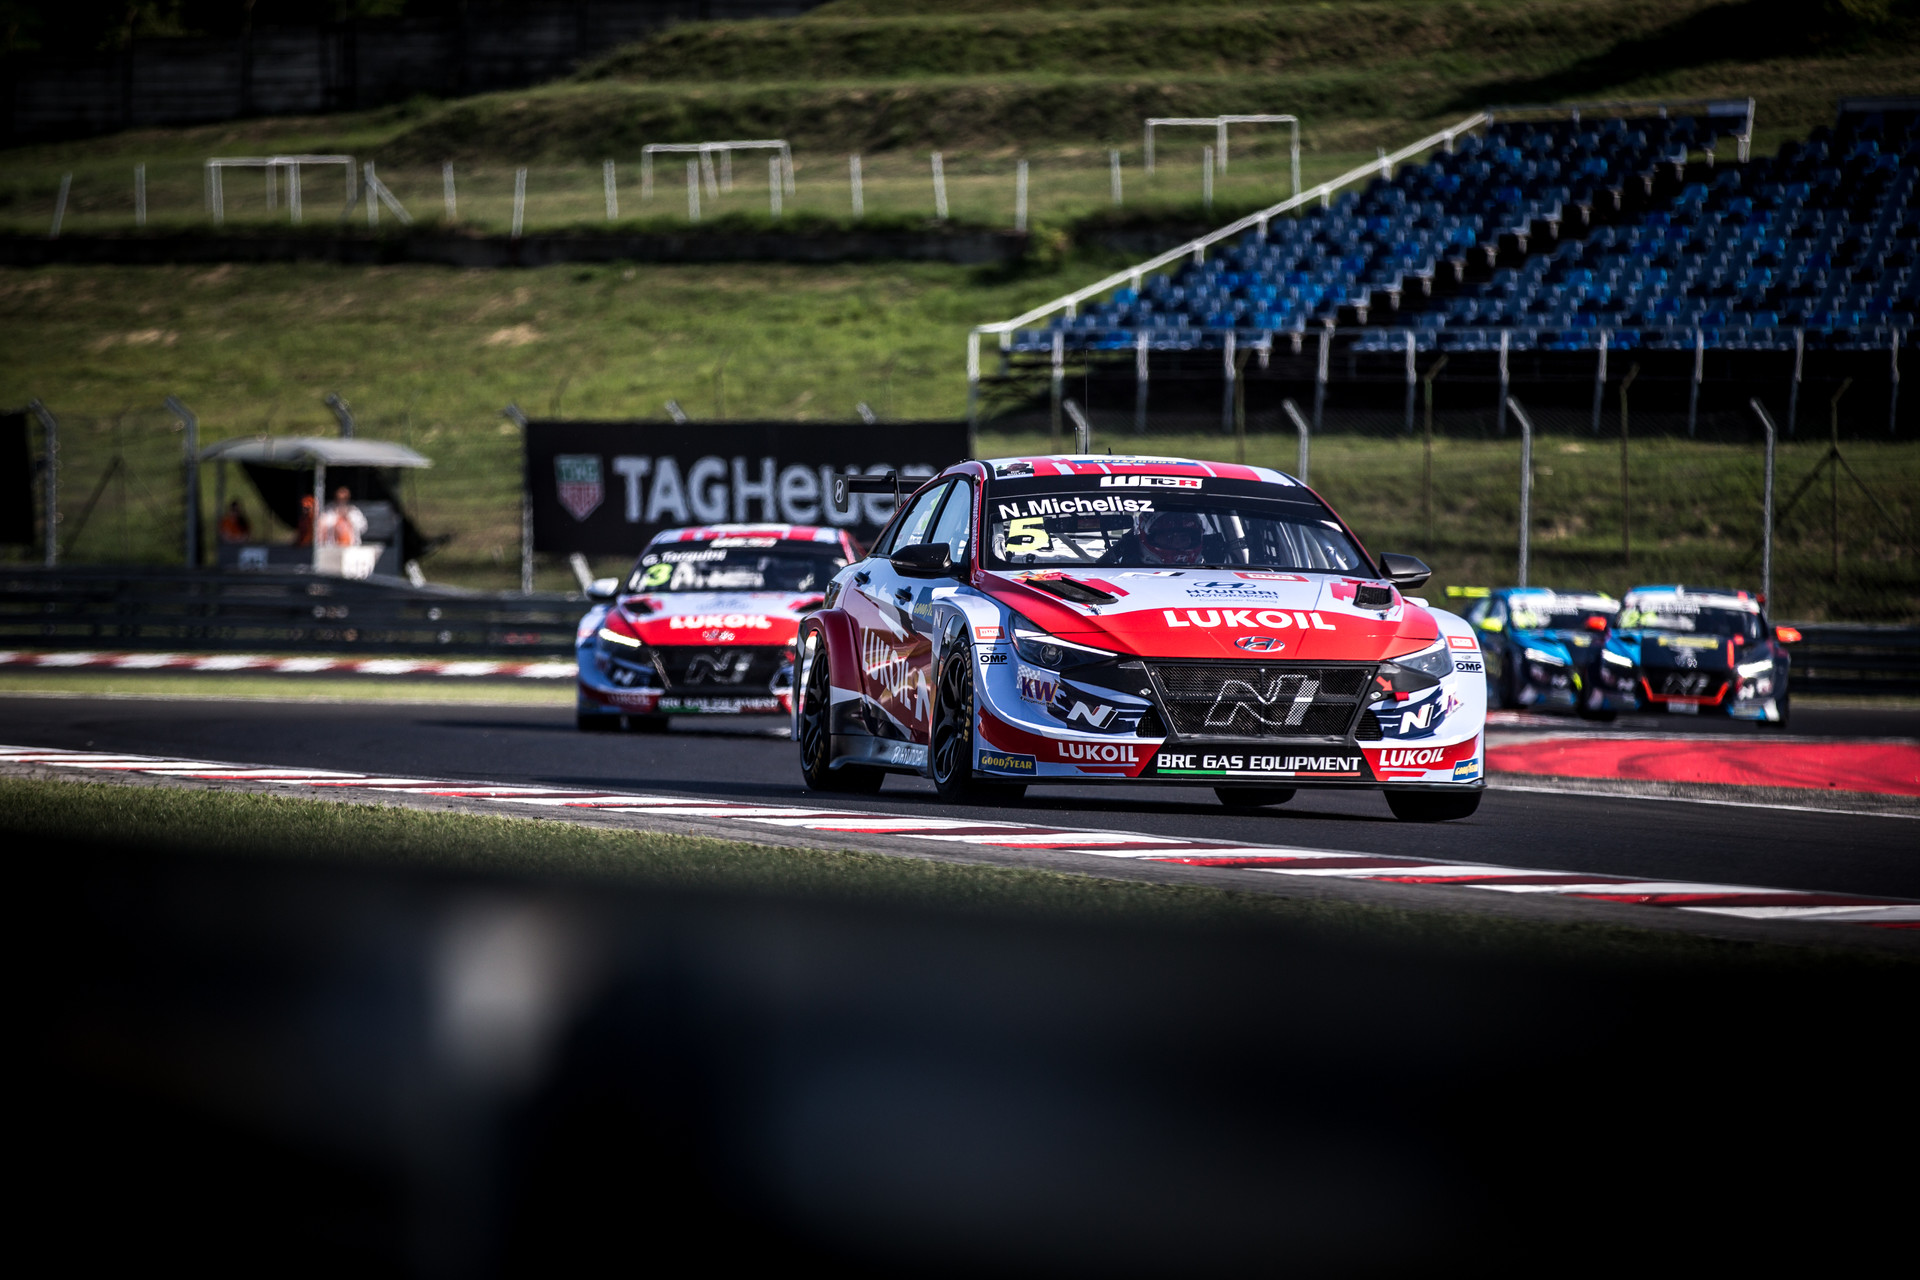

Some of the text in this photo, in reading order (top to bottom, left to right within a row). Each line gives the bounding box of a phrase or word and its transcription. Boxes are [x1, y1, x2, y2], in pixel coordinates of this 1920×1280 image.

[1100, 476, 1203, 489] WTCR
[998, 496, 1155, 520] N.Michelisz
[1006, 517, 1050, 553] 5
[646, 563, 673, 586] 3
[670, 614, 772, 629] LUKOIL
[1163, 610, 1337, 631] LUKOIL
[862, 626, 911, 711] LUKOIL
[980, 654, 1008, 663] OMP
[1455, 662, 1482, 672] OMP
[1021, 676, 1060, 704] KW
[981, 755, 1033, 769] GOODYEAR
[1058, 742, 1139, 762] LUKOIL
[1379, 747, 1444, 767] LUKOIL
[1157, 753, 1362, 772] BRC GAS EQUIPMENT
